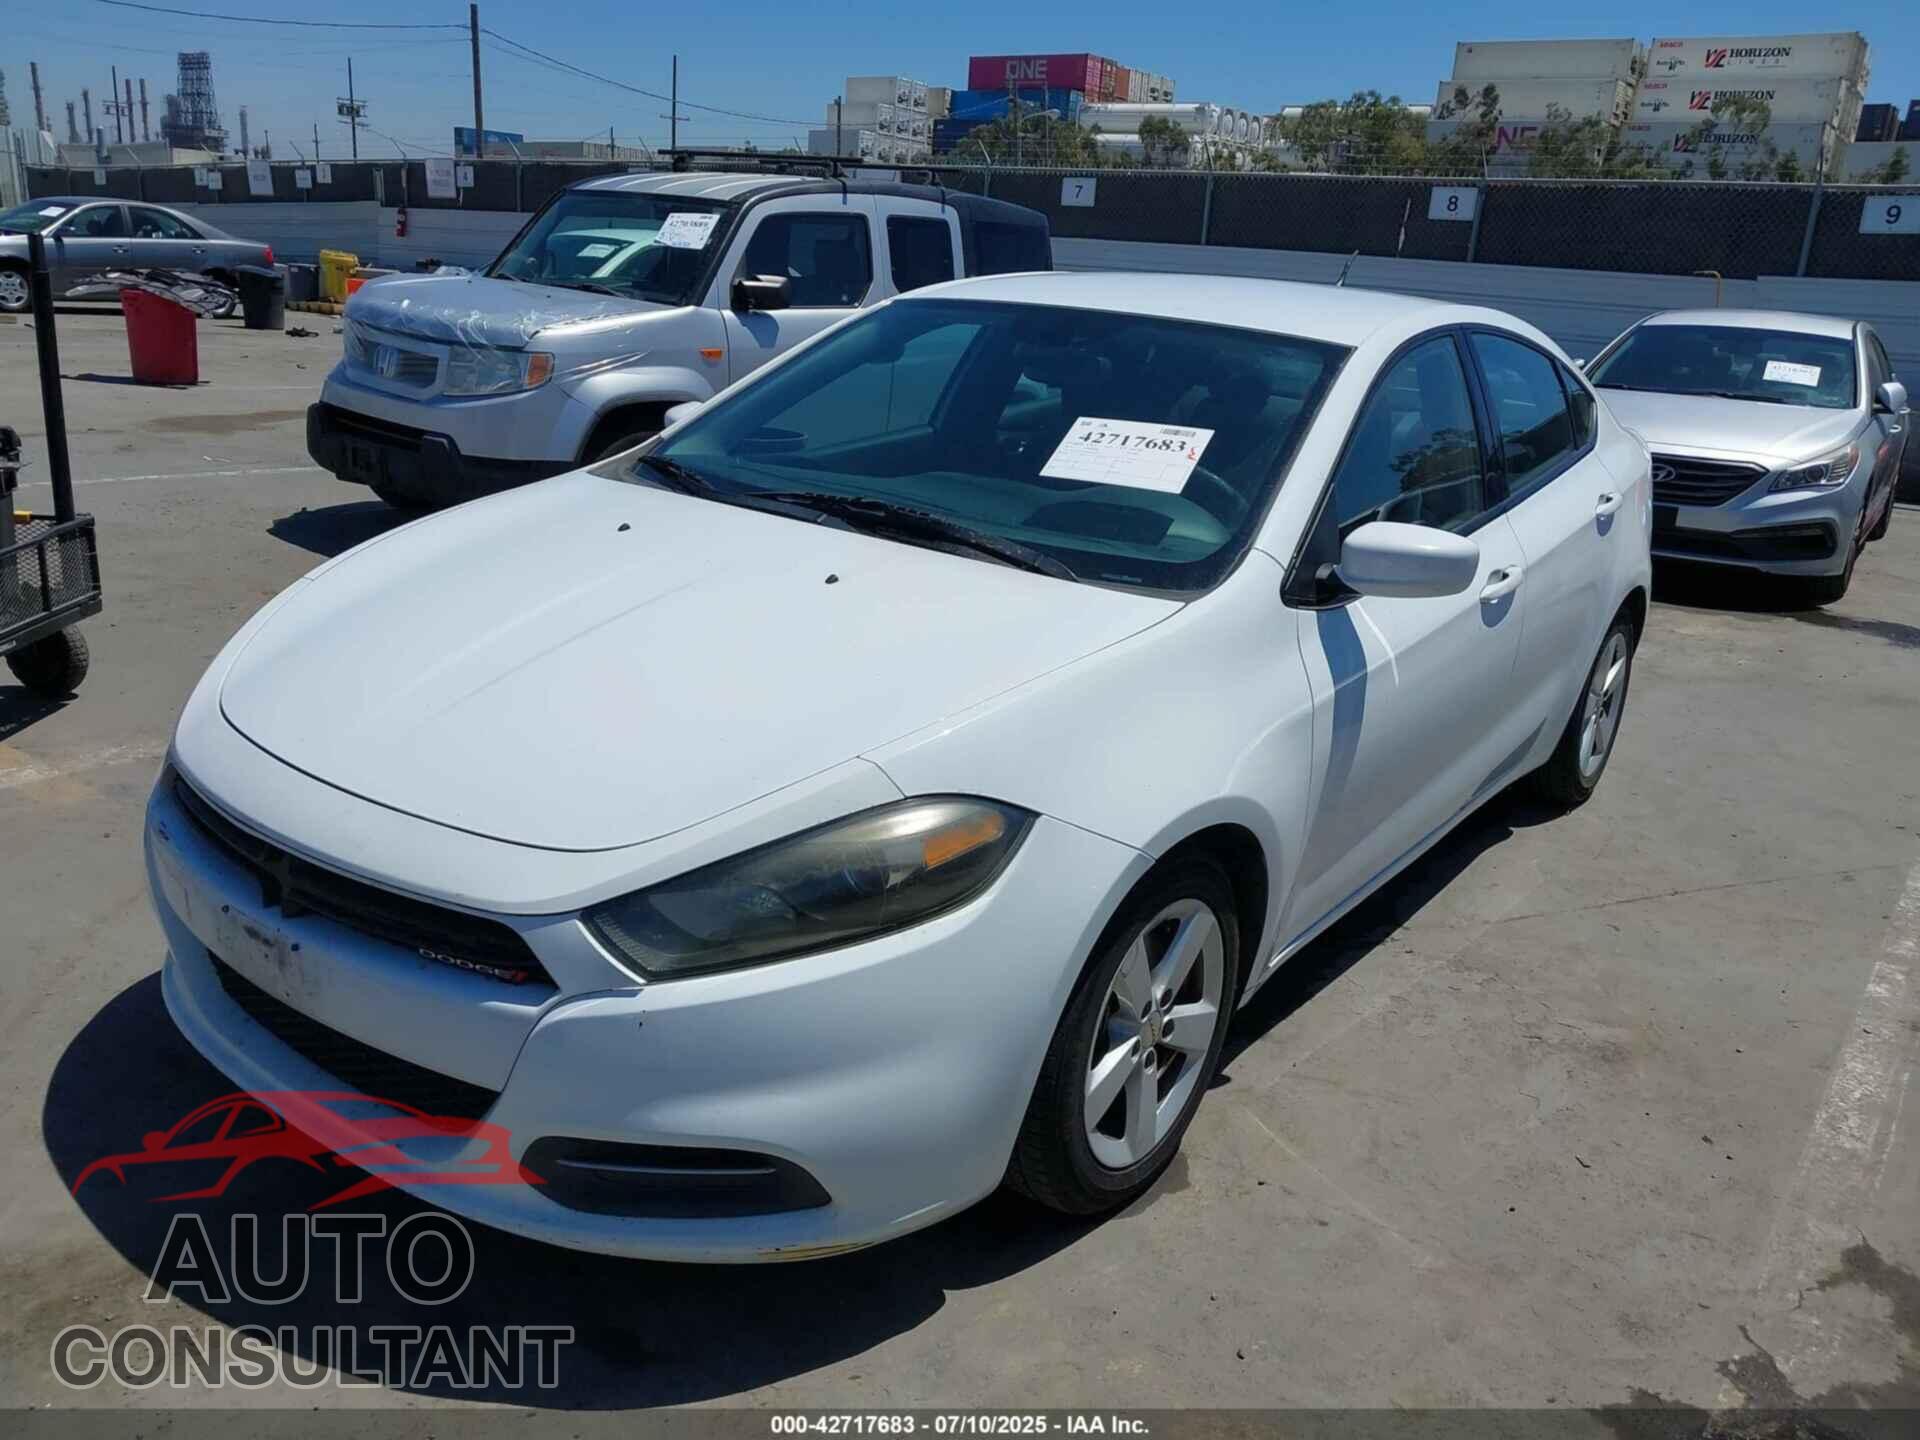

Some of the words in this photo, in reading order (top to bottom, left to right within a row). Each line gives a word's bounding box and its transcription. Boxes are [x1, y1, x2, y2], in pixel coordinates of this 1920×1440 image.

[1729, 47, 1792, 58] HORIZON
[1006, 59, 1047, 79] ONE
[1075, 184, 1083, 199] 7
[1447, 195, 1458, 211] 8
[1885, 205, 1901, 224] 9
[1078, 431, 1187, 452] 42717683
